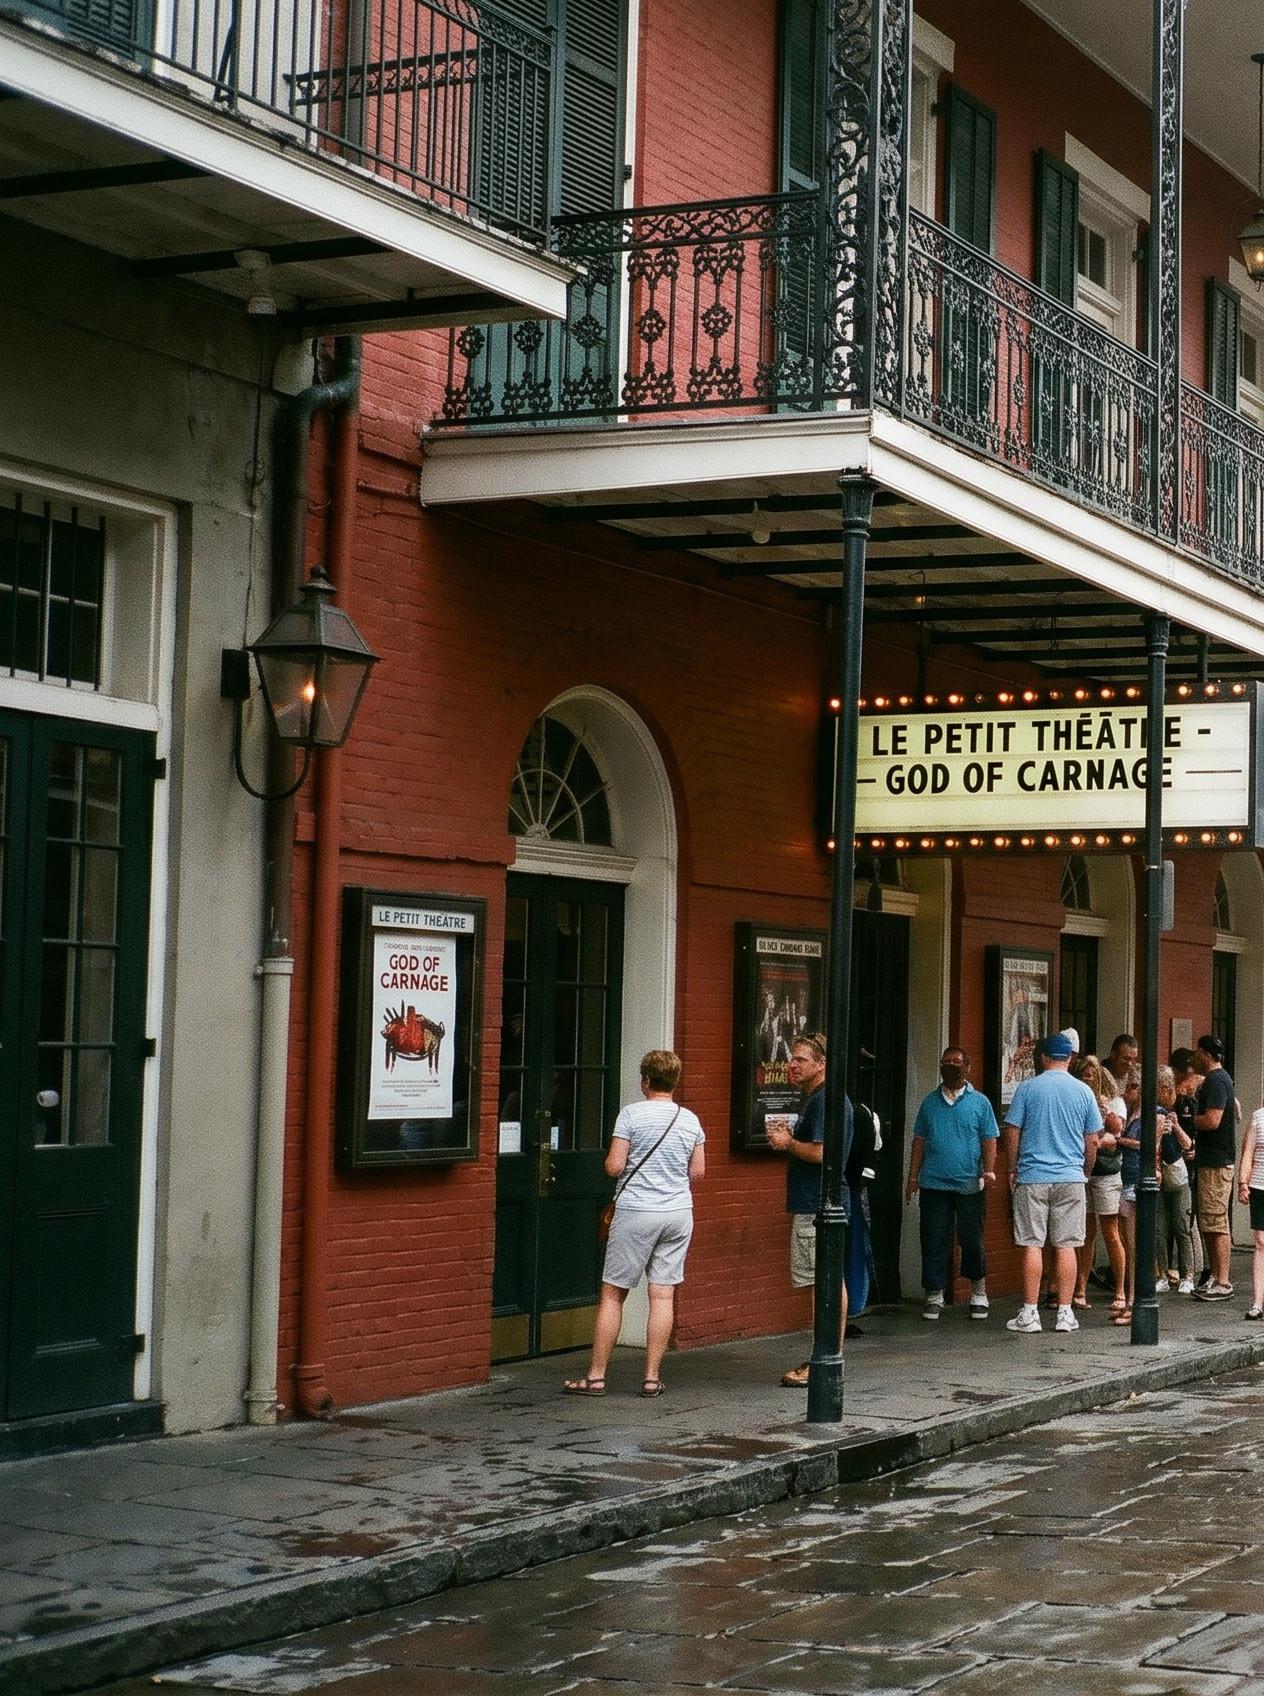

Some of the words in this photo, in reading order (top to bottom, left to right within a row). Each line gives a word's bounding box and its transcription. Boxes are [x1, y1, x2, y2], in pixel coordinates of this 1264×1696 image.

[873, 724, 908, 756] LE
[924, 722, 1016, 755] PETIT
[886, 763, 950, 795] GOD
[963, 762, 1003, 793] OF
[379, 910, 391, 922] LE
[393, 911, 420, 925] PETIT
[389, 954, 419, 971] GOD
[423, 956, 440, 972] OF
[380, 972, 448, 992] CARNAGE
